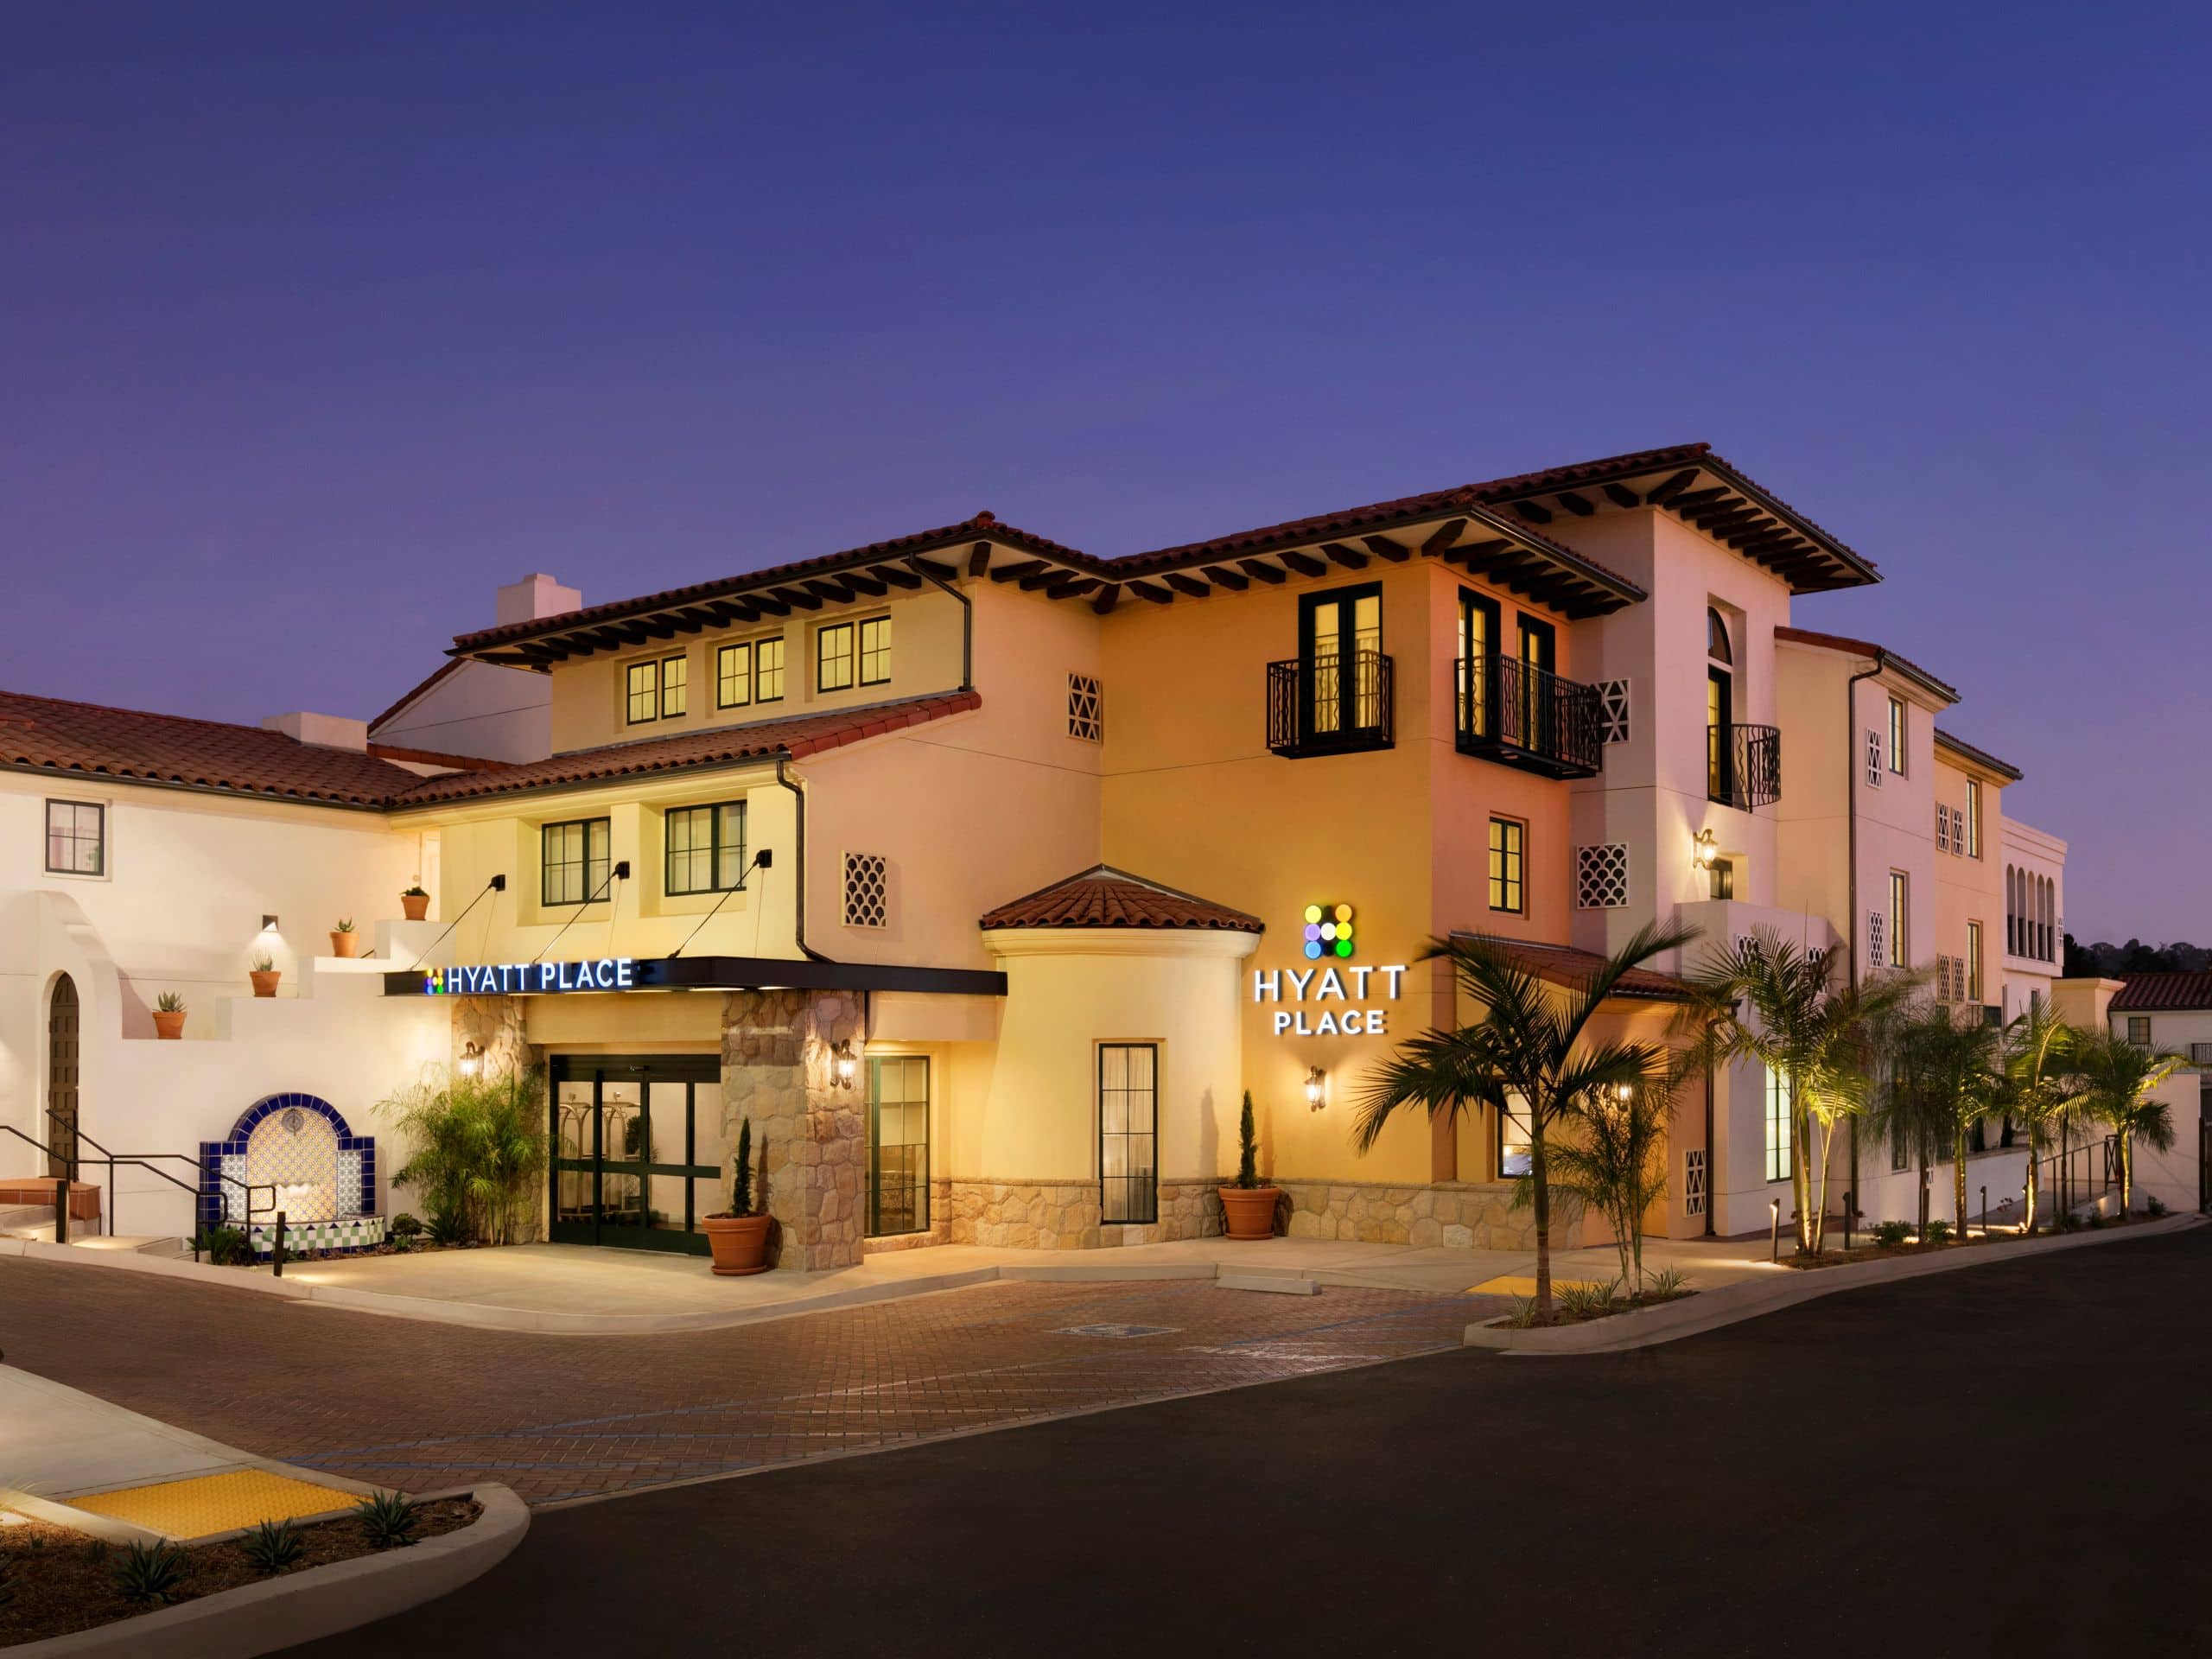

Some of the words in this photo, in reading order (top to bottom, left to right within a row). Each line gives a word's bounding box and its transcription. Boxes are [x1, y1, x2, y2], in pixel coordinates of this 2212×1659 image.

[448, 963, 530, 993] HYATT
[540, 957, 632, 991] PLACE
[1255, 964, 1406, 1002] HYATT
[1274, 1009, 1384, 1035] PLACE
